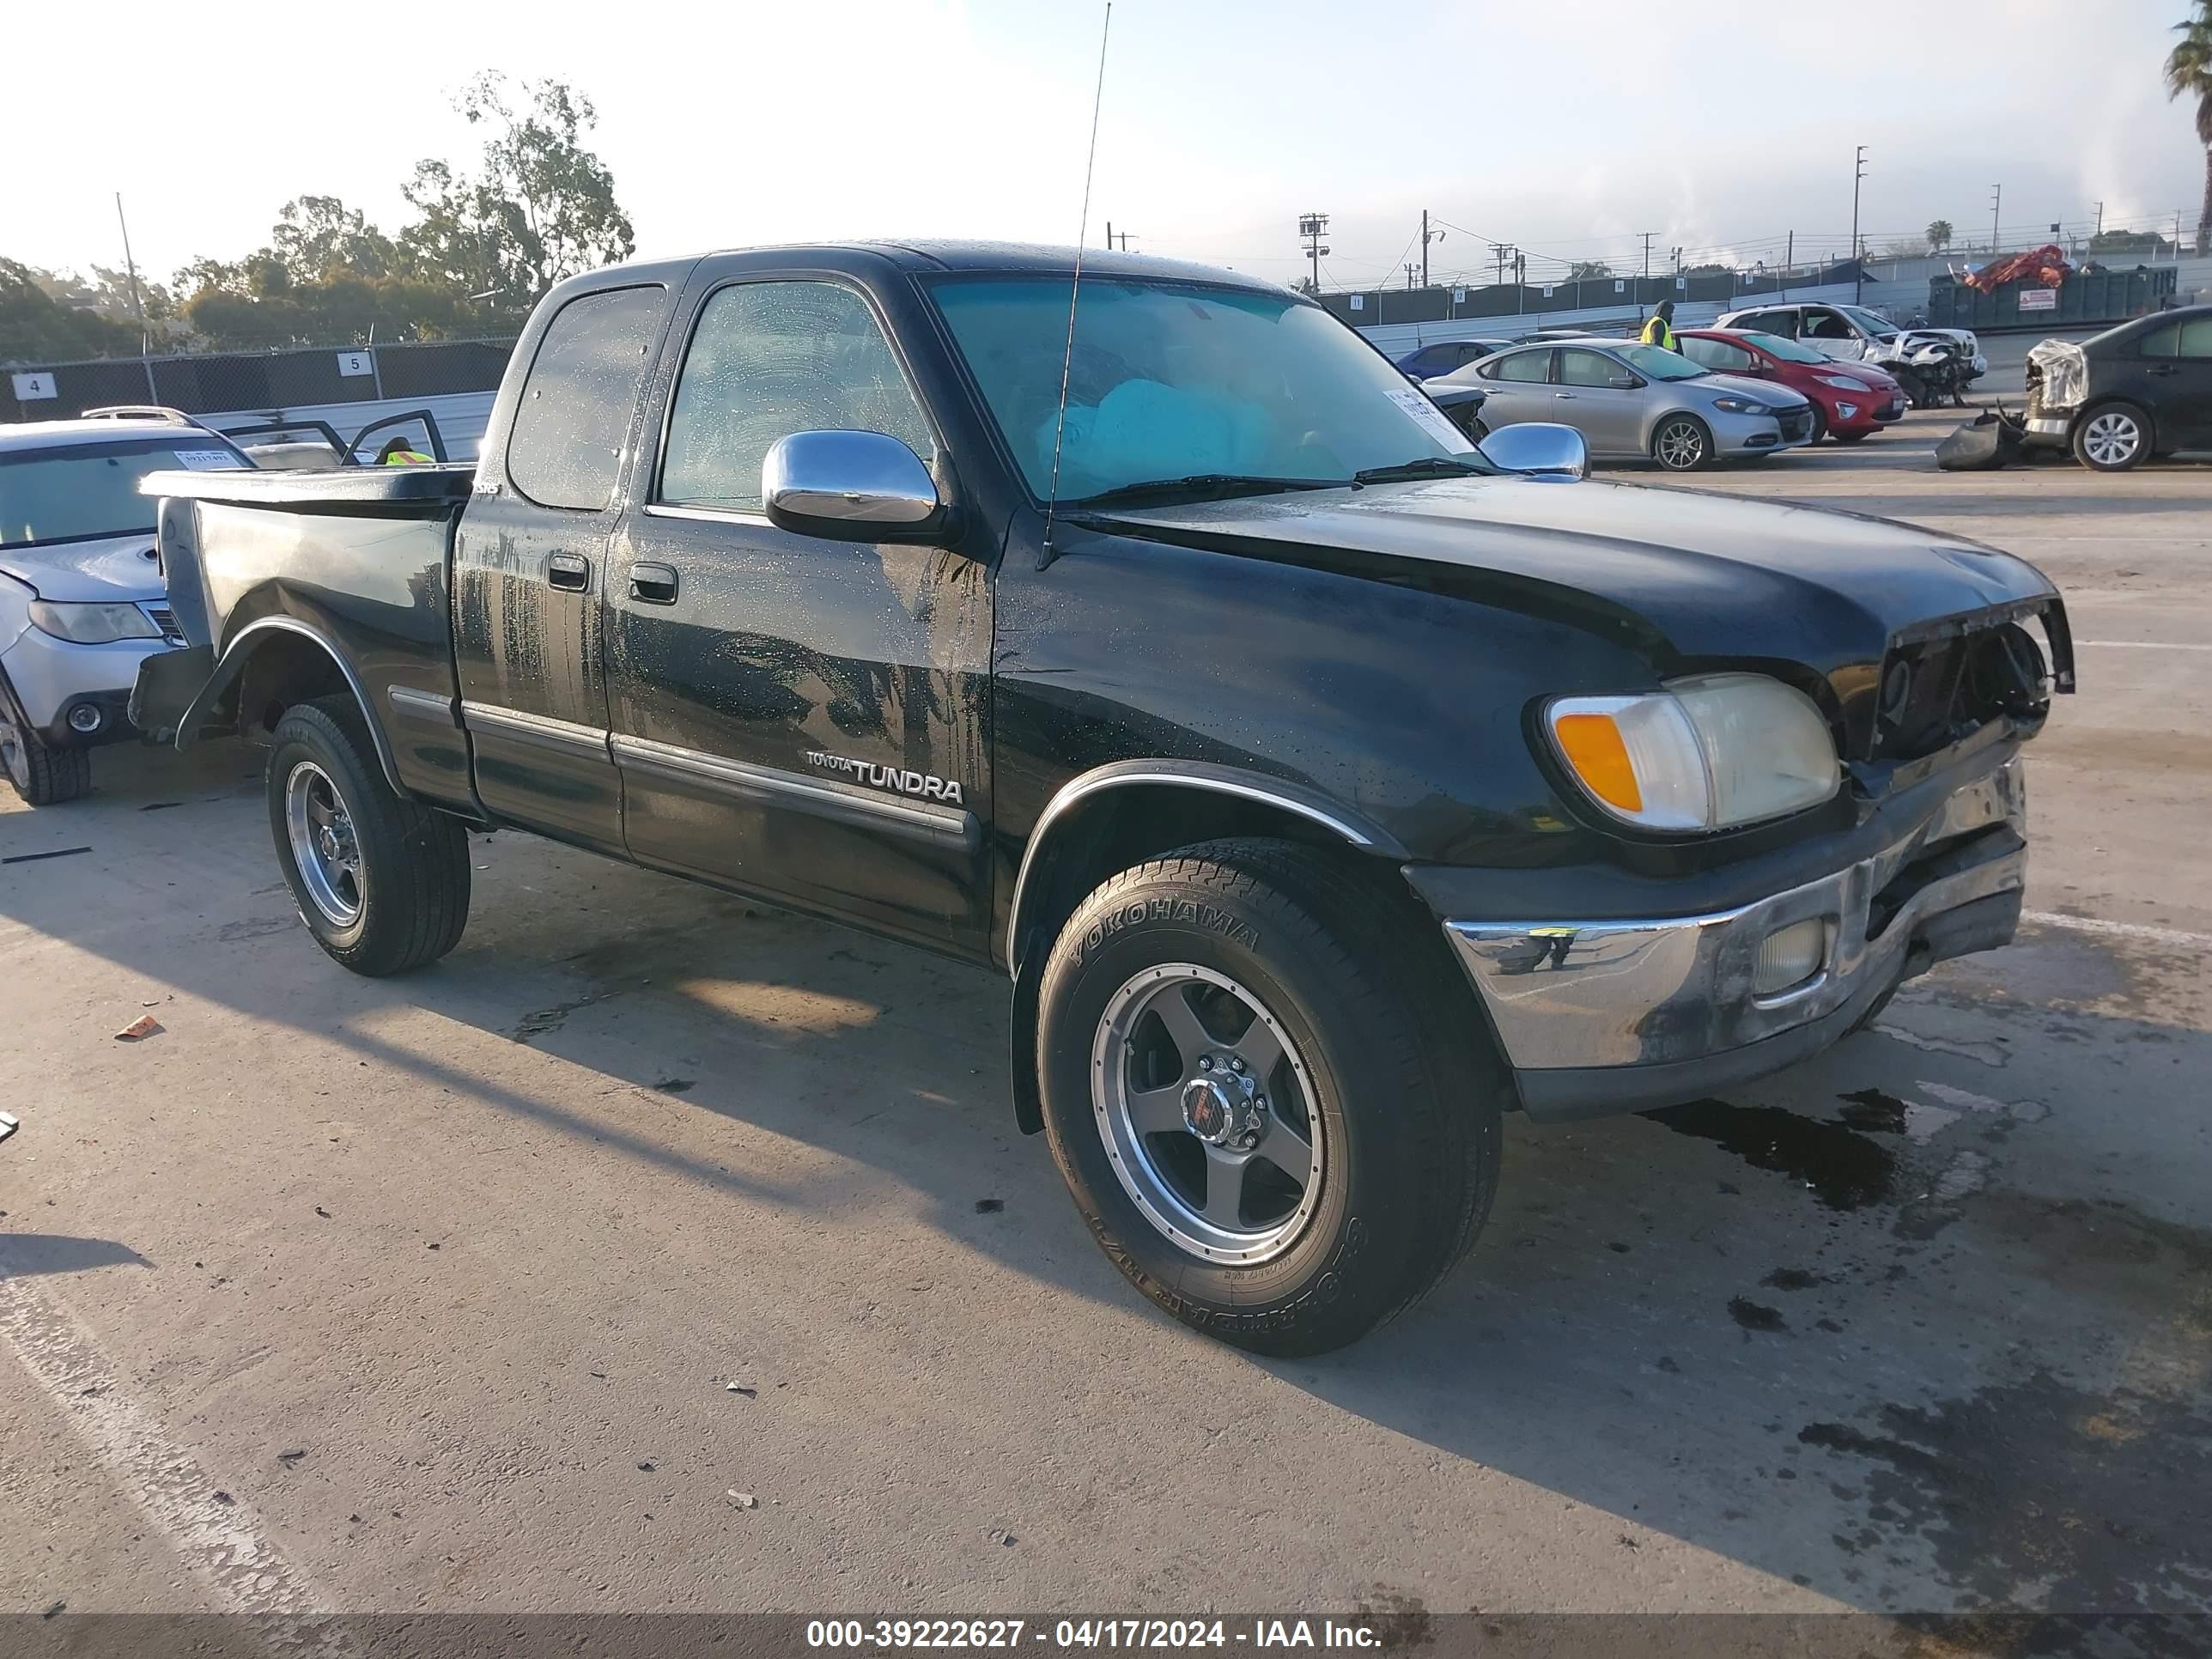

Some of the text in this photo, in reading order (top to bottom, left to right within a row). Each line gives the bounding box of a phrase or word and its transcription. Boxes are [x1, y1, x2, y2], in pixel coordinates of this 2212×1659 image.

[1354, 298, 1360, 307] 11
[351, 358, 360, 370] 5
[30, 380, 40, 392] 4
[806, 750, 963, 805] TOYOTA TUNDRA
[1068, 898, 1261, 969] YOKOHAMA
